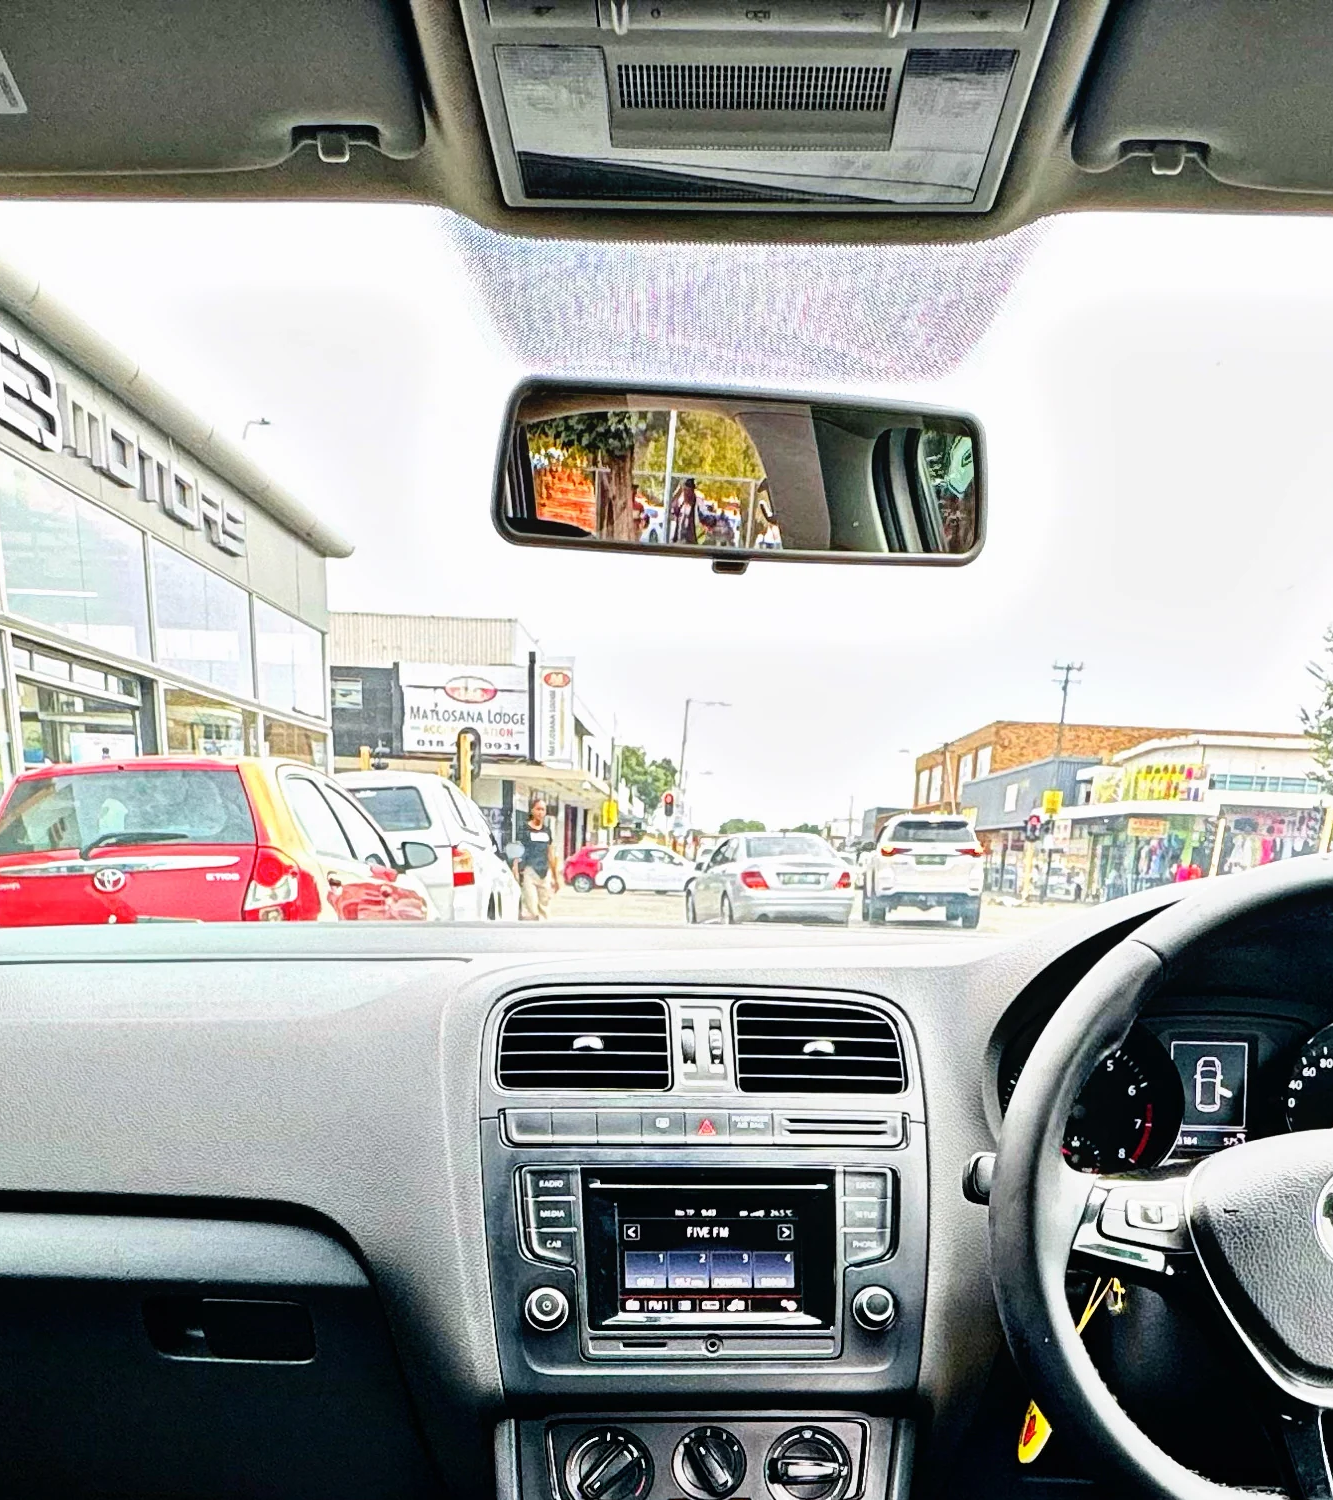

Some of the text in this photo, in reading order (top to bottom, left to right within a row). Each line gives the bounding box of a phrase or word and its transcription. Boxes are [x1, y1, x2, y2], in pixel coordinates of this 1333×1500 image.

[487, 708, 526, 726] LODGE
[1106, 1059, 1115, 1072] 5
[1319, 1058, 1333, 1069] 80
[1302, 1067, 1317, 1077] 60
[1127, 1084, 1137, 1097] 6
[1288, 1080, 1303, 1091] 40
[1133, 1118, 1143, 1130] 7
[1117, 1147, 1127, 1159] 8
[539, 1180, 564, 1188] RADIO
[539, 1209, 565, 1218] MEDIA
[686, 1226, 730, 1238] FIVE FM
[546, 1239, 562, 1248] CAR
[852, 1240, 877, 1248] PHONE
[658, 1253, 664, 1263] 1
[699, 1253, 706, 1263] 2
[784, 1253, 791, 1263] 4
